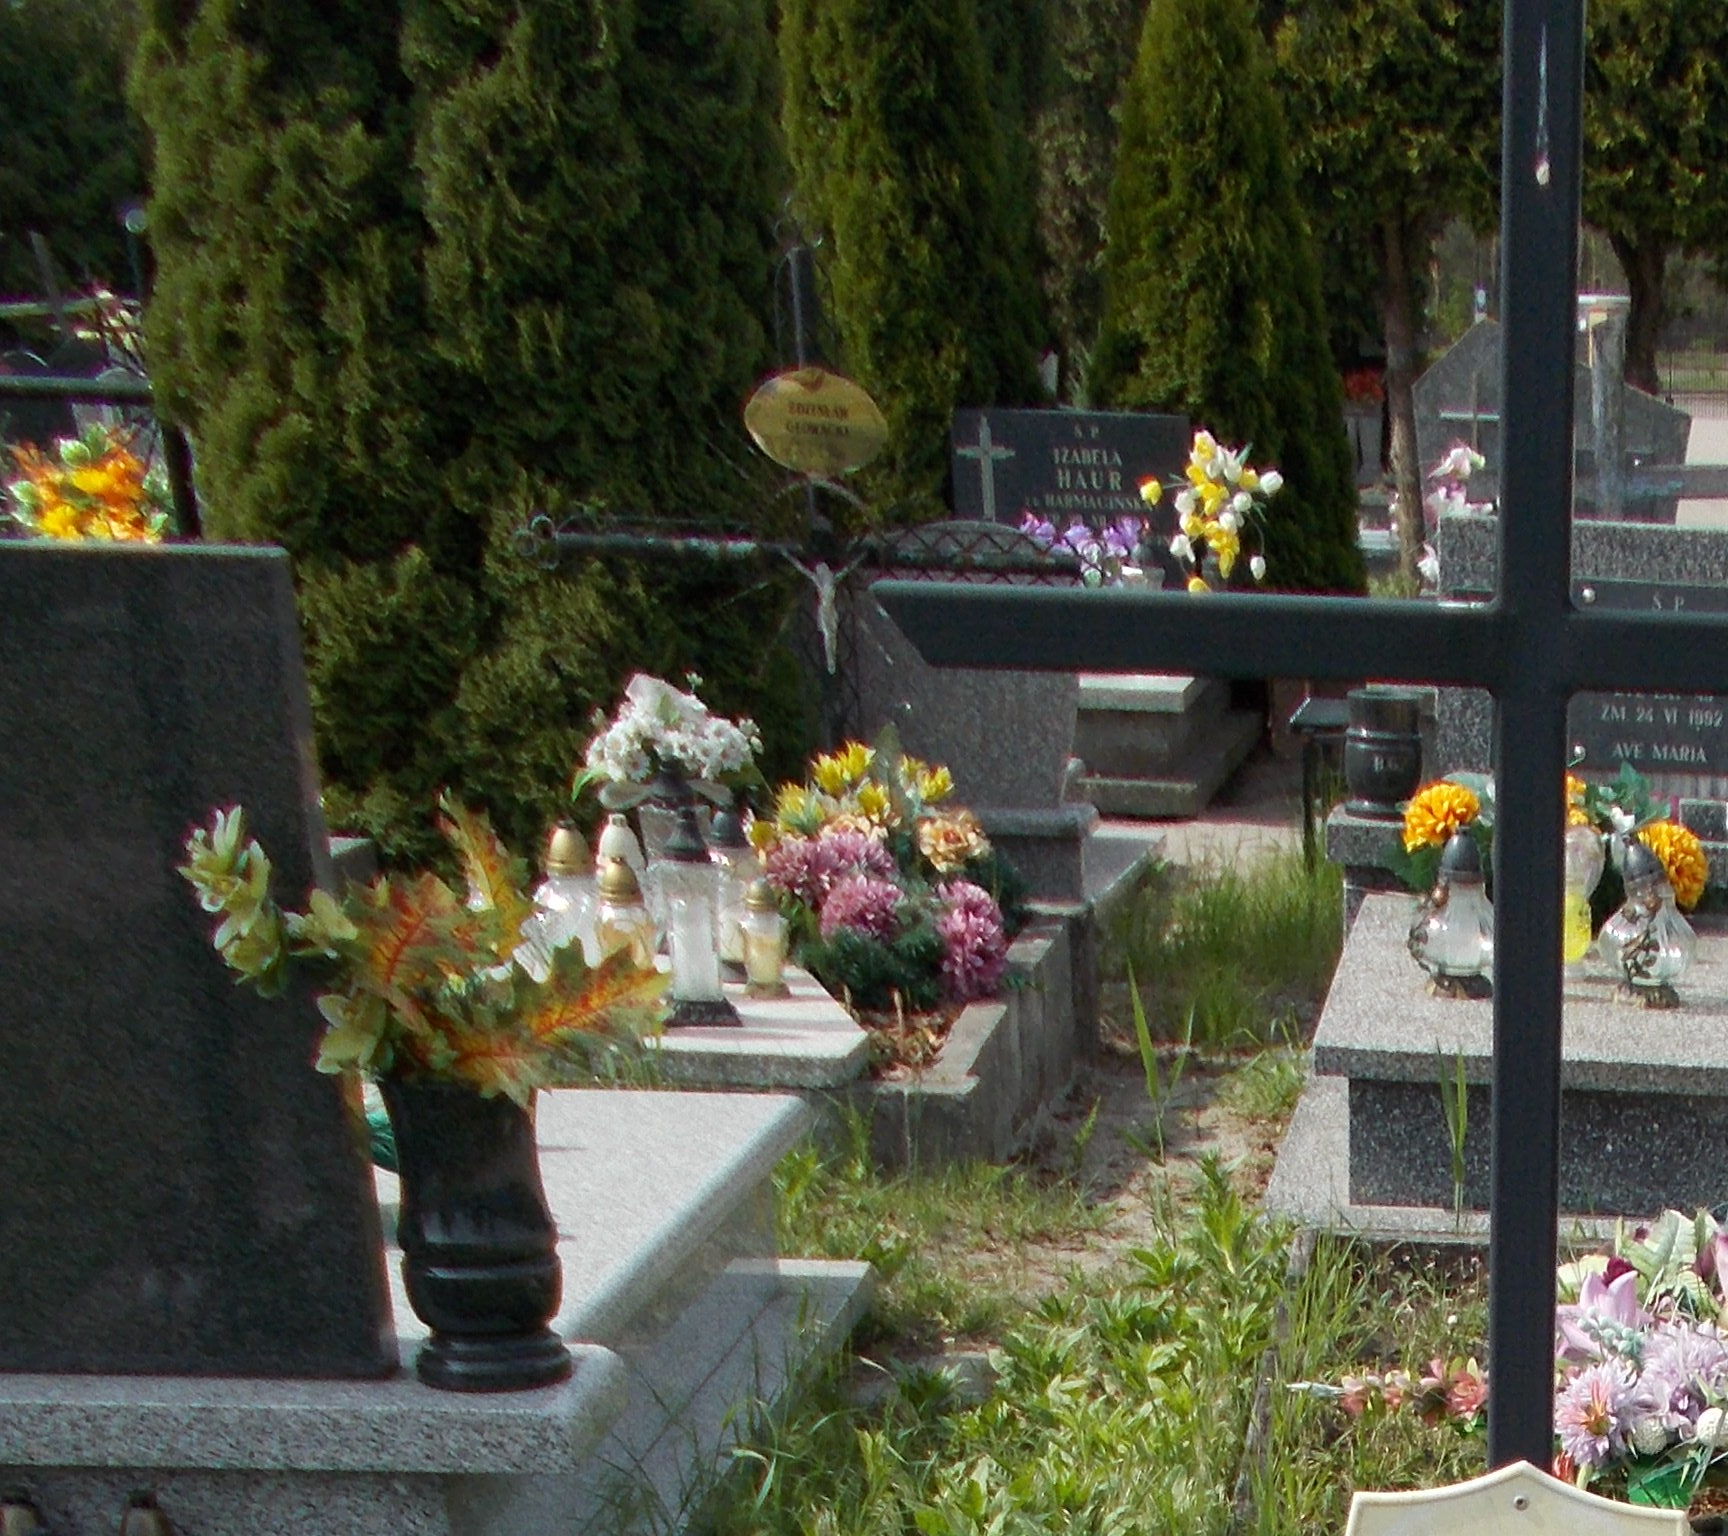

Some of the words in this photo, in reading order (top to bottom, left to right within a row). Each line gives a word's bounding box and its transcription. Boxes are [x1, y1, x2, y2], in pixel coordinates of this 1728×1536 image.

[1052, 447, 1123, 467] IZABELA
[1057, 467, 1122, 491] HAUR
[1611, 741, 1645, 760] AVE
[1651, 743, 1709, 763] MARIA
